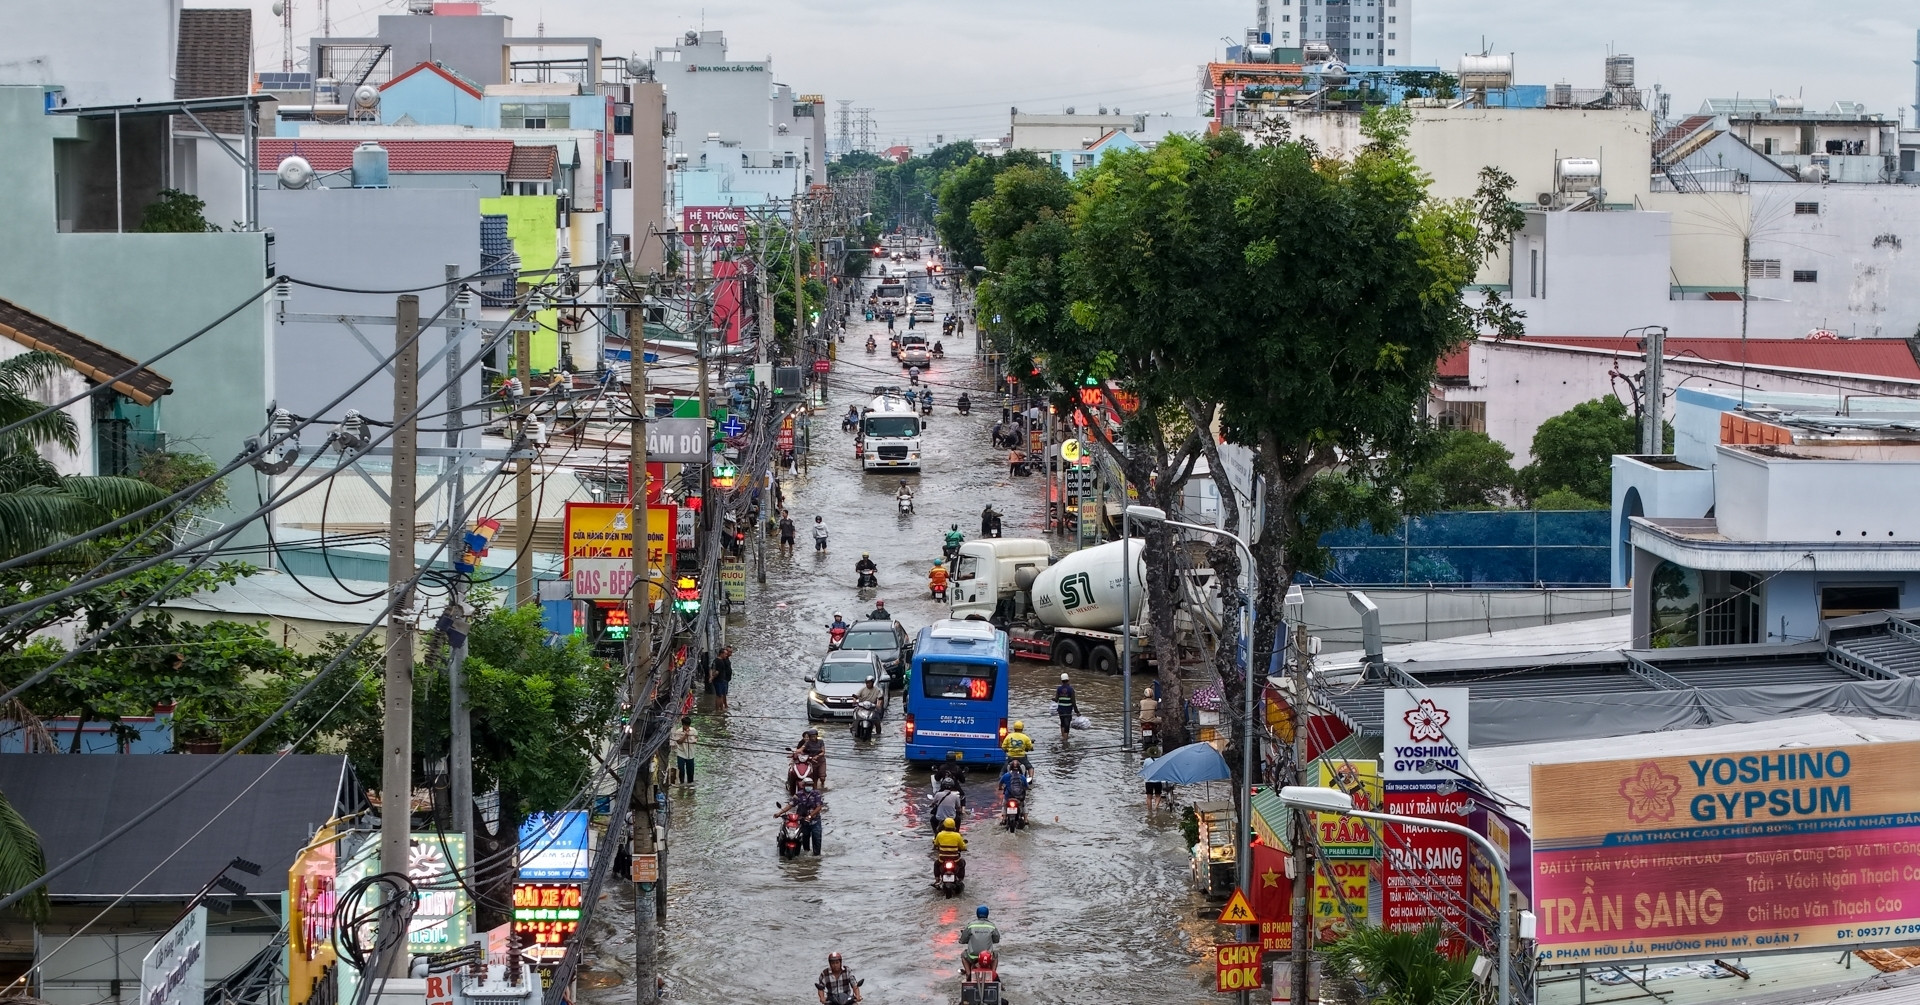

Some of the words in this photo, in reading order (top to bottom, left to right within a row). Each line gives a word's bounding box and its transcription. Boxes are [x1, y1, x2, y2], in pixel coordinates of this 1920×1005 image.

[646, 427, 674, 454] ẦM
[681, 427, 702, 454] ĐỒ
[576, 570, 601, 595] GAS
[1394, 746, 1459, 758] YOSHINO
[1394, 759, 1459, 771] GYPUM
[1688, 750, 1850, 787] YOSHINO
[1406, 800, 1415, 814] LÝ
[1416, 797, 1437, 814] TRẦN
[1689, 785, 1851, 822] GYPSUM
[1692, 829, 1719, 837] CAO
[1425, 847, 1463, 869] SANG
[1564, 856, 1576, 872] LÝ
[1694, 853, 1722, 865] CAO
[1860, 866, 1899, 888] Thạch
[515, 886, 539, 907] BÃI
[540, 889, 559, 907] XE
[1540, 876, 1624, 936] TRẦN
[1634, 887, 1724, 930] SANG
[1774, 906, 1799, 920] Hoa
[1833, 898, 1871, 919] Thạch
[1875, 896, 1903, 913] Cao
[1857, 926, 1891, 937] 09377
[1218, 945, 1260, 966] CHAY
[1539, 951, 1553, 959] 68
[1557, 947, 1591, 960] PHẠM
[1651, 938, 1701, 952] PHƯỜNG
[1705, 935, 1728, 948] PHÚ
[1756, 932, 1789, 946] QUẬN
[1793, 934, 1799, 942] 7
